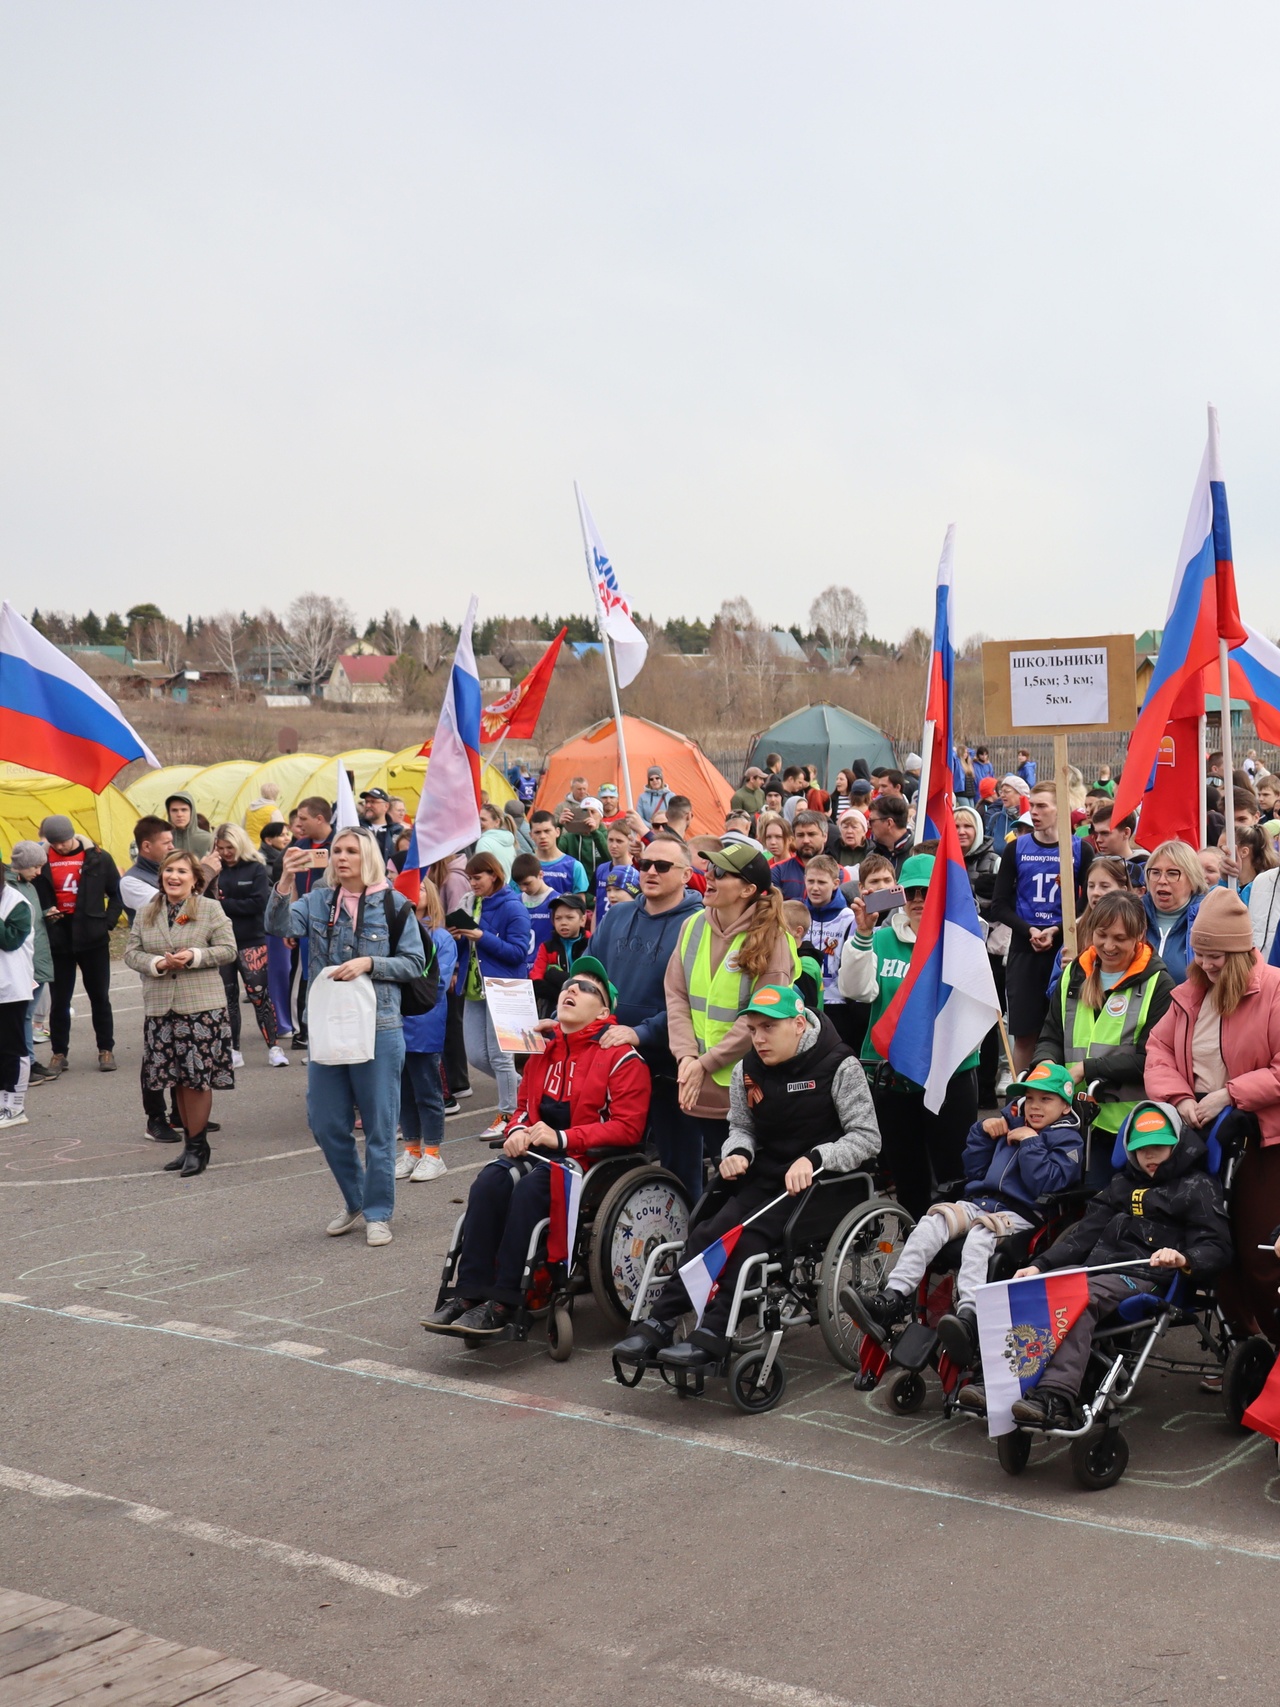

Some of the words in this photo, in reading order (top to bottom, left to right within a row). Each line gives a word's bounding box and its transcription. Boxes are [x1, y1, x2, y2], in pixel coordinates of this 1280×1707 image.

[1013, 653, 1104, 669] ШКОЛЬНИКИ
[1024, 675, 1060, 688] 1,5км;
[1063, 674, 1070, 686] 3
[1073, 675, 1094, 686] км;
[1045, 694, 1072, 705] 5км.
[63, 873, 78, 894] 4
[1032, 873, 1061, 903] 17
[788, 1081, 809, 1092] PUMA
[636, 1206, 662, 1221] СОЧИ
[664, 1210, 681, 1235] 2014
